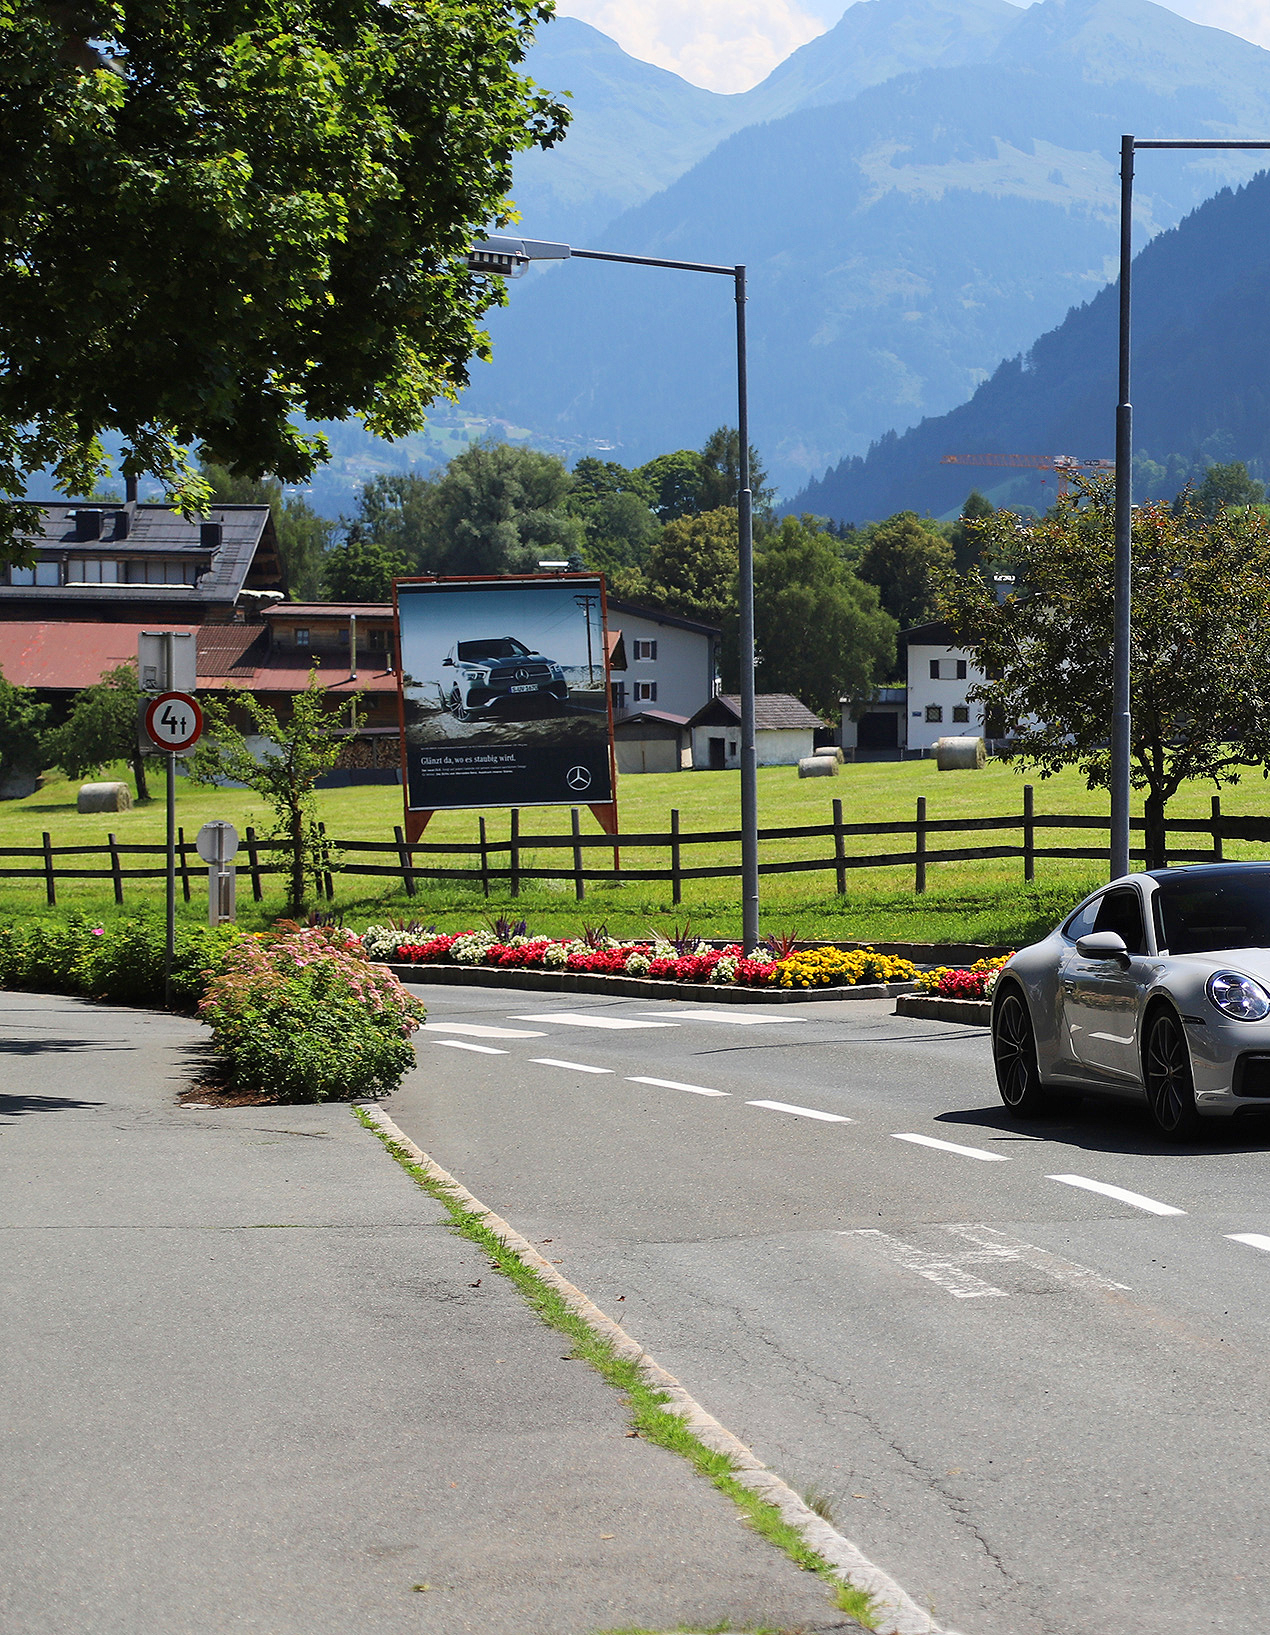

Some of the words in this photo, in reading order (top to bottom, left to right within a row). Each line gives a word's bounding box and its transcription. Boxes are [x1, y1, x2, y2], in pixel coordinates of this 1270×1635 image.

[420, 756, 442, 765] Glänzt
[443, 756, 454, 765] da,
[474, 754, 498, 764] staubig
[499, 754, 516, 762] wird.
